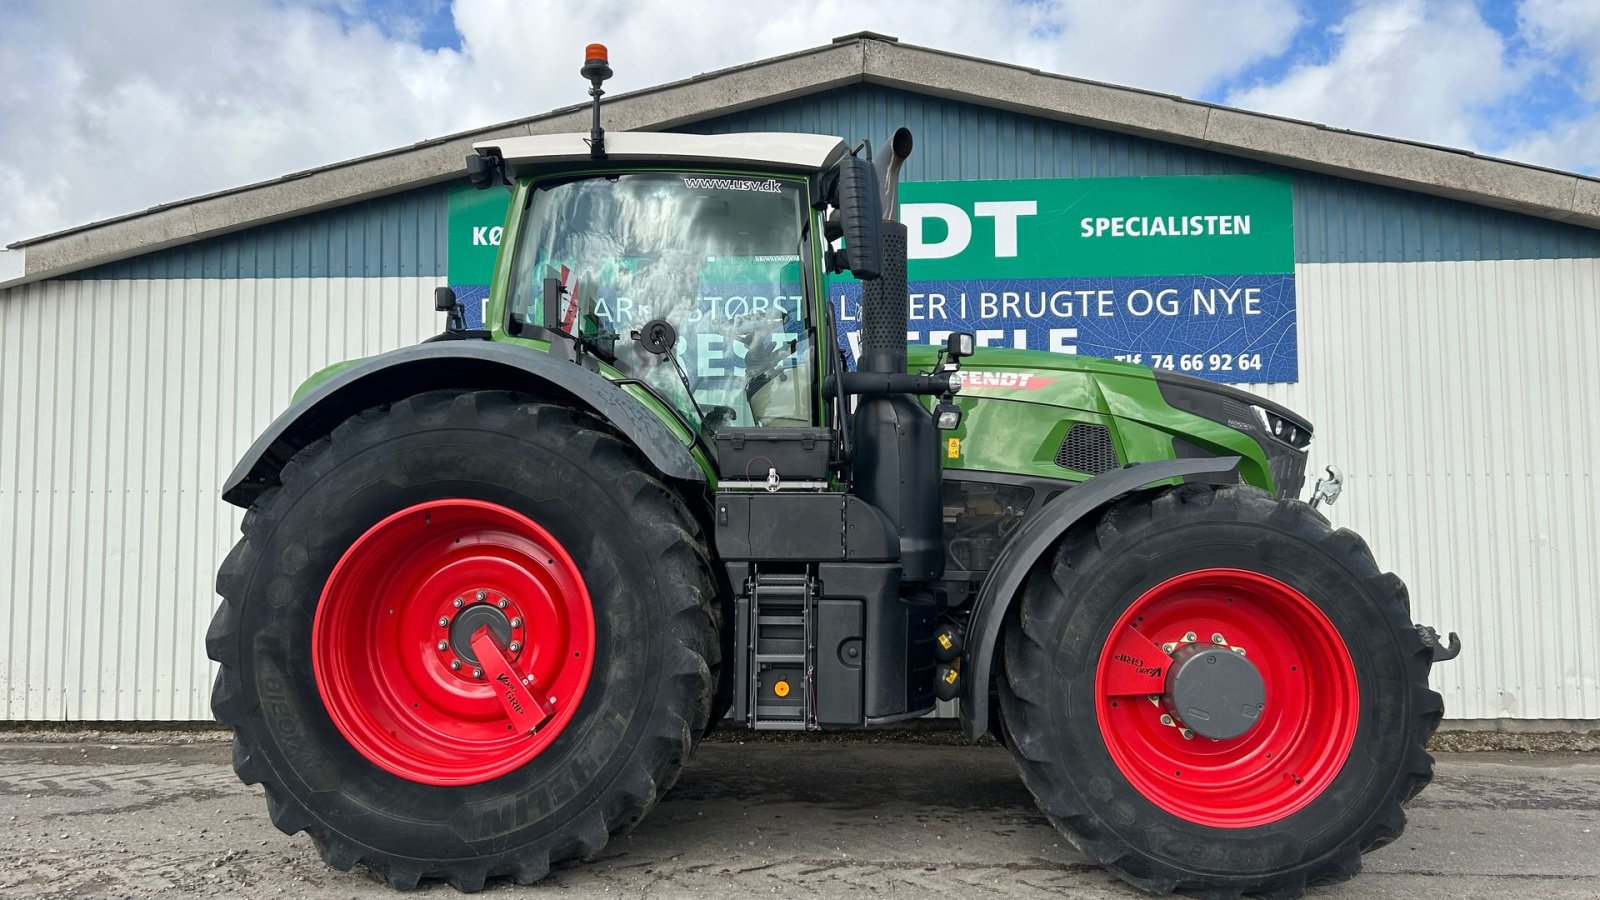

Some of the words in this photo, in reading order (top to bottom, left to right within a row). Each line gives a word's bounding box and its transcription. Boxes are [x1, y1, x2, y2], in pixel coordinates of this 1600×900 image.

[684, 178, 782, 193] www.usv.dk
[1080, 215, 1251, 238] SPECIALISTEN
[472, 226, 504, 246] KØ
[840, 293, 948, 321] LER
[960, 292, 967, 320] I
[980, 289, 1114, 320] BRUGTE
[1127, 289, 1180, 316] OG
[1193, 288, 1262, 316] NYE
[1151, 354, 1175, 371] 74
[1180, 354, 1204, 371] 66
[1209, 354, 1233, 371] 92
[1238, 354, 1262, 370] 64
[959, 371, 1035, 387] FENDT
[1114, 653, 1144, 667] GRIP
[505, 690, 525, 715] GRIP
